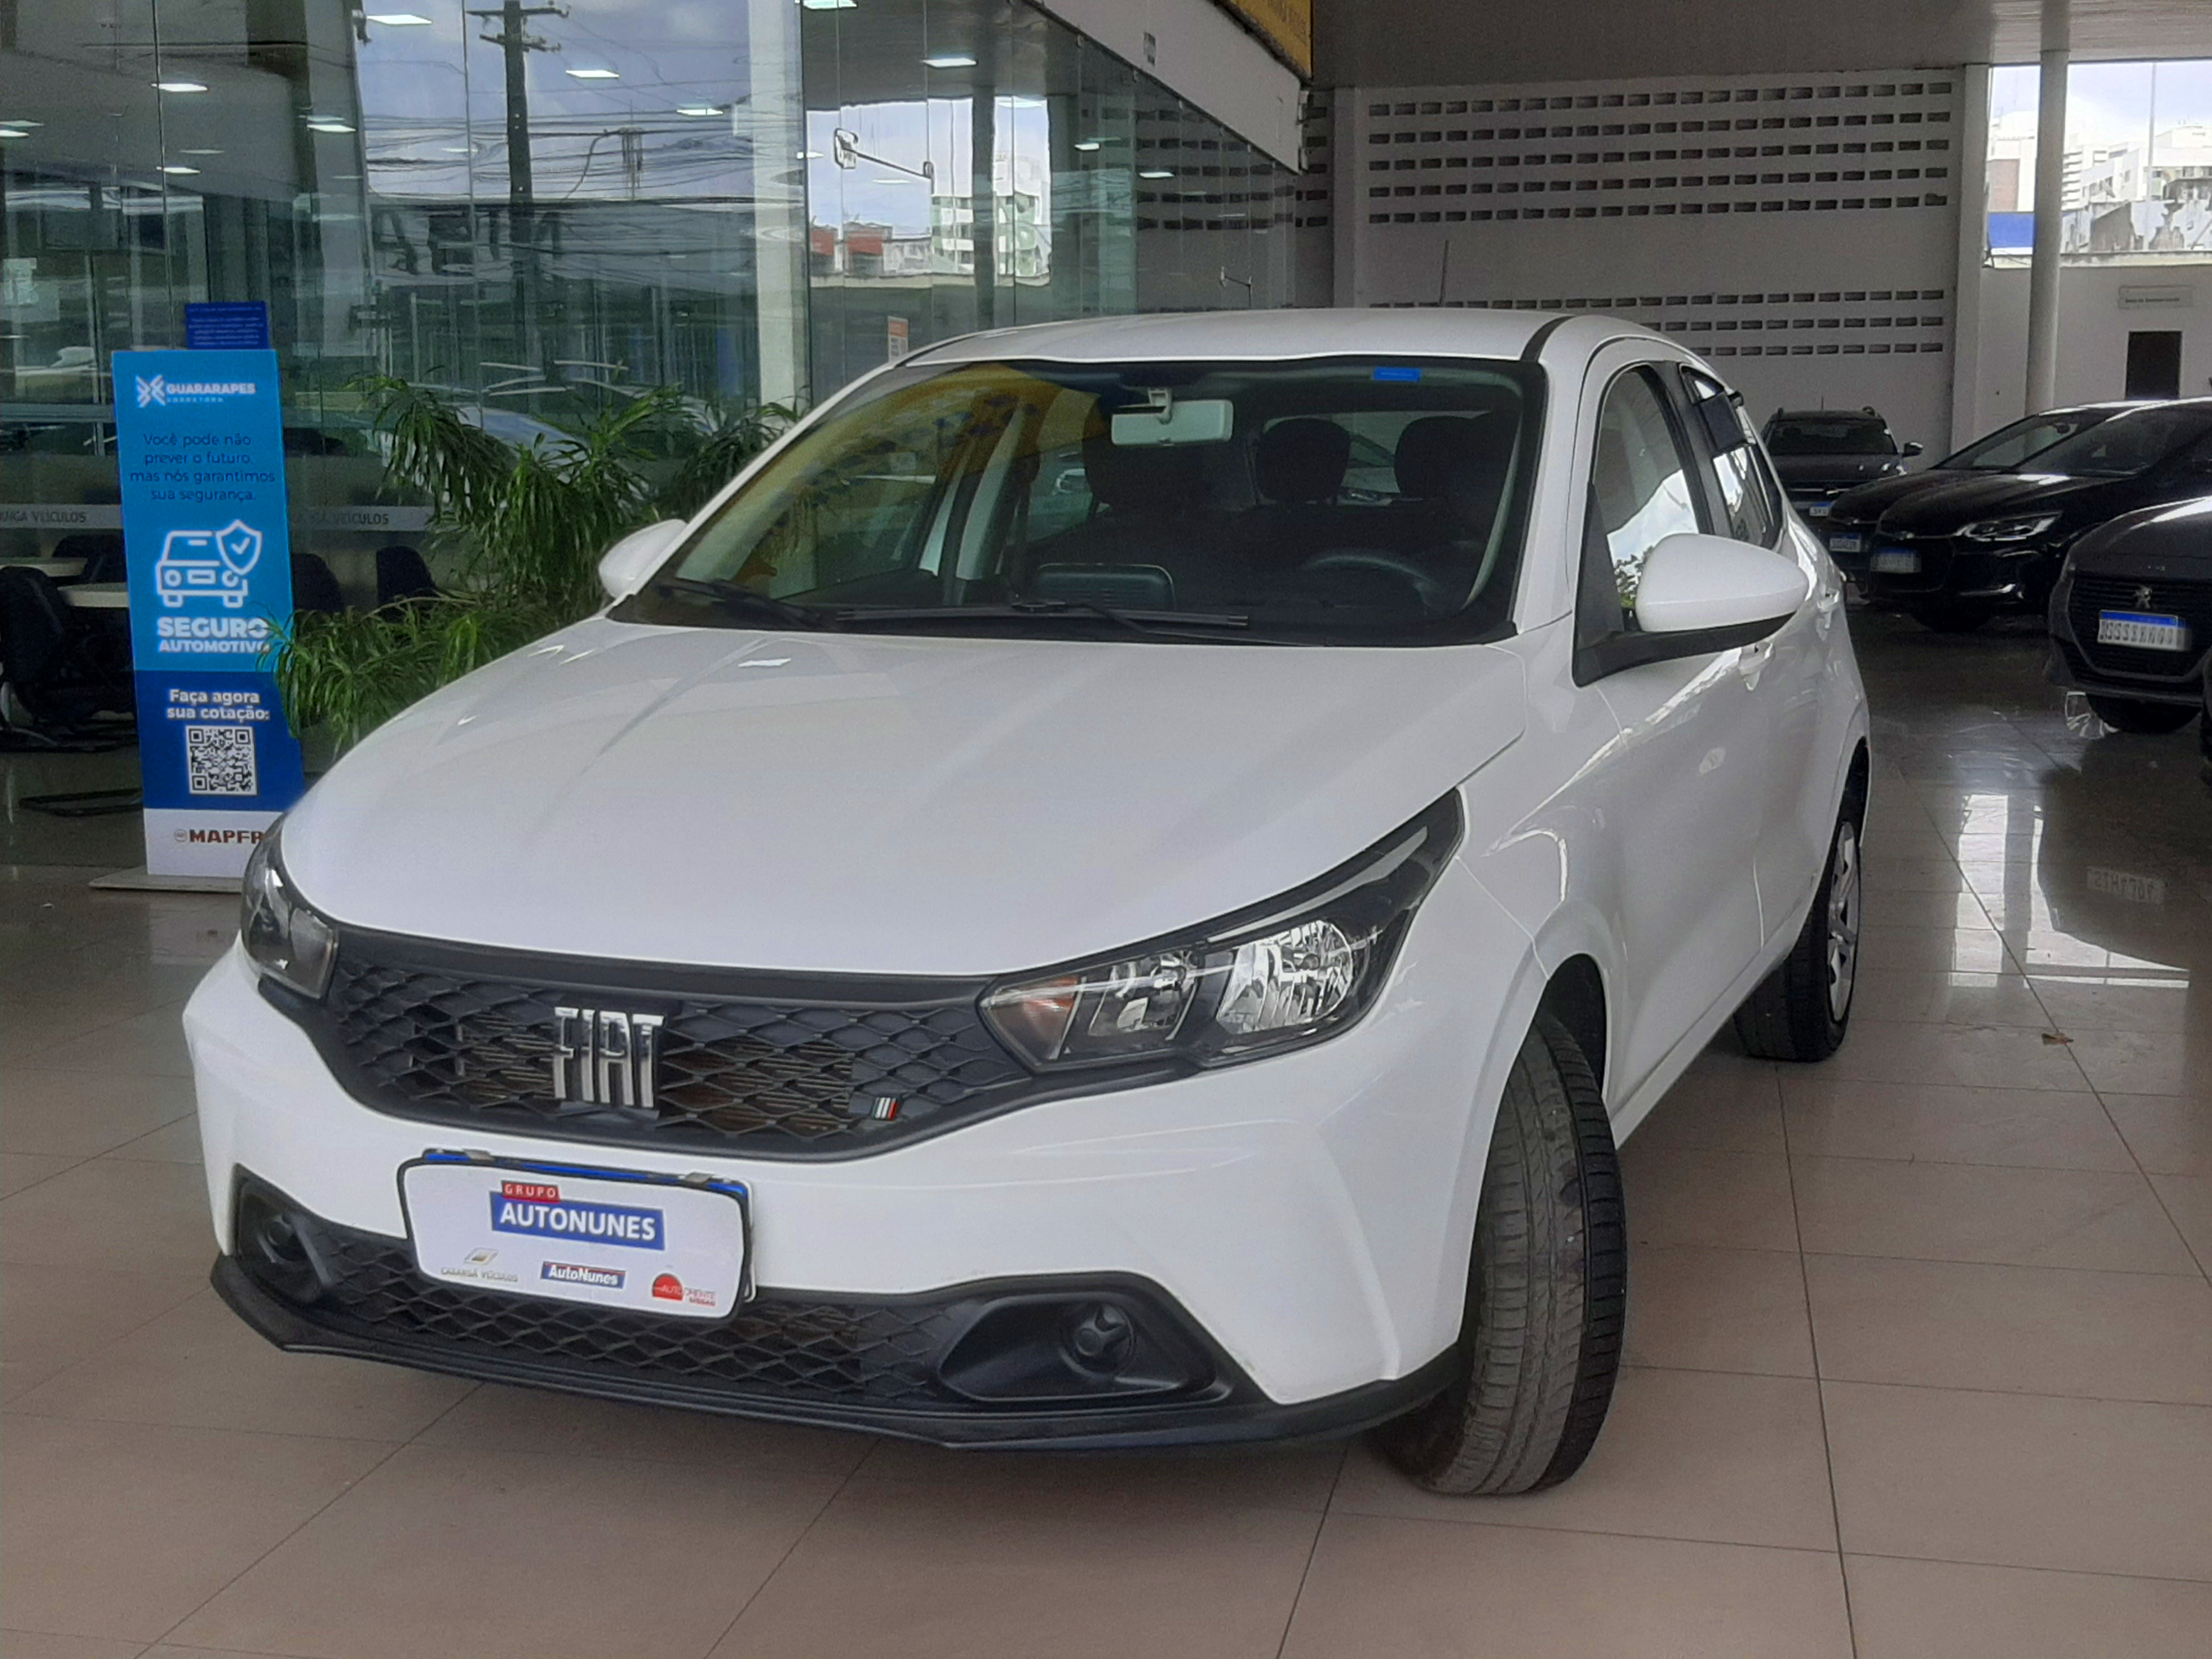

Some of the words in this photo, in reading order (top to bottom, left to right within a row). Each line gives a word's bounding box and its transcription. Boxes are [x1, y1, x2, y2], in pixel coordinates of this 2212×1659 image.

[166, 383, 256, 395] GUARARAPES
[143, 433, 178, 446] Você
[183, 434, 220, 448] pode
[225, 433, 252, 446] não
[145, 453, 189, 466] prever
[194, 453, 202, 463] o
[131, 472, 160, 482] mas
[165, 470, 189, 482] nós
[194, 470, 275, 484] garantimos
[152, 490, 175, 500] sua
[181, 490, 256, 503] segurança.
[157, 617, 269, 638] SEGURO
[169, 689, 208, 706] Faça
[212, 691, 260, 706] agora
[168, 707, 196, 719] sua
[200, 706, 270, 723] cotação:
[189, 829, 264, 844] MAPFR
[554, 1006, 665, 1108] FIAT
[504, 1183, 556, 1198] GRUPO
[500, 1202, 656, 1241] AUTONUNES
[548, 1264, 619, 1286] AutoNunes
